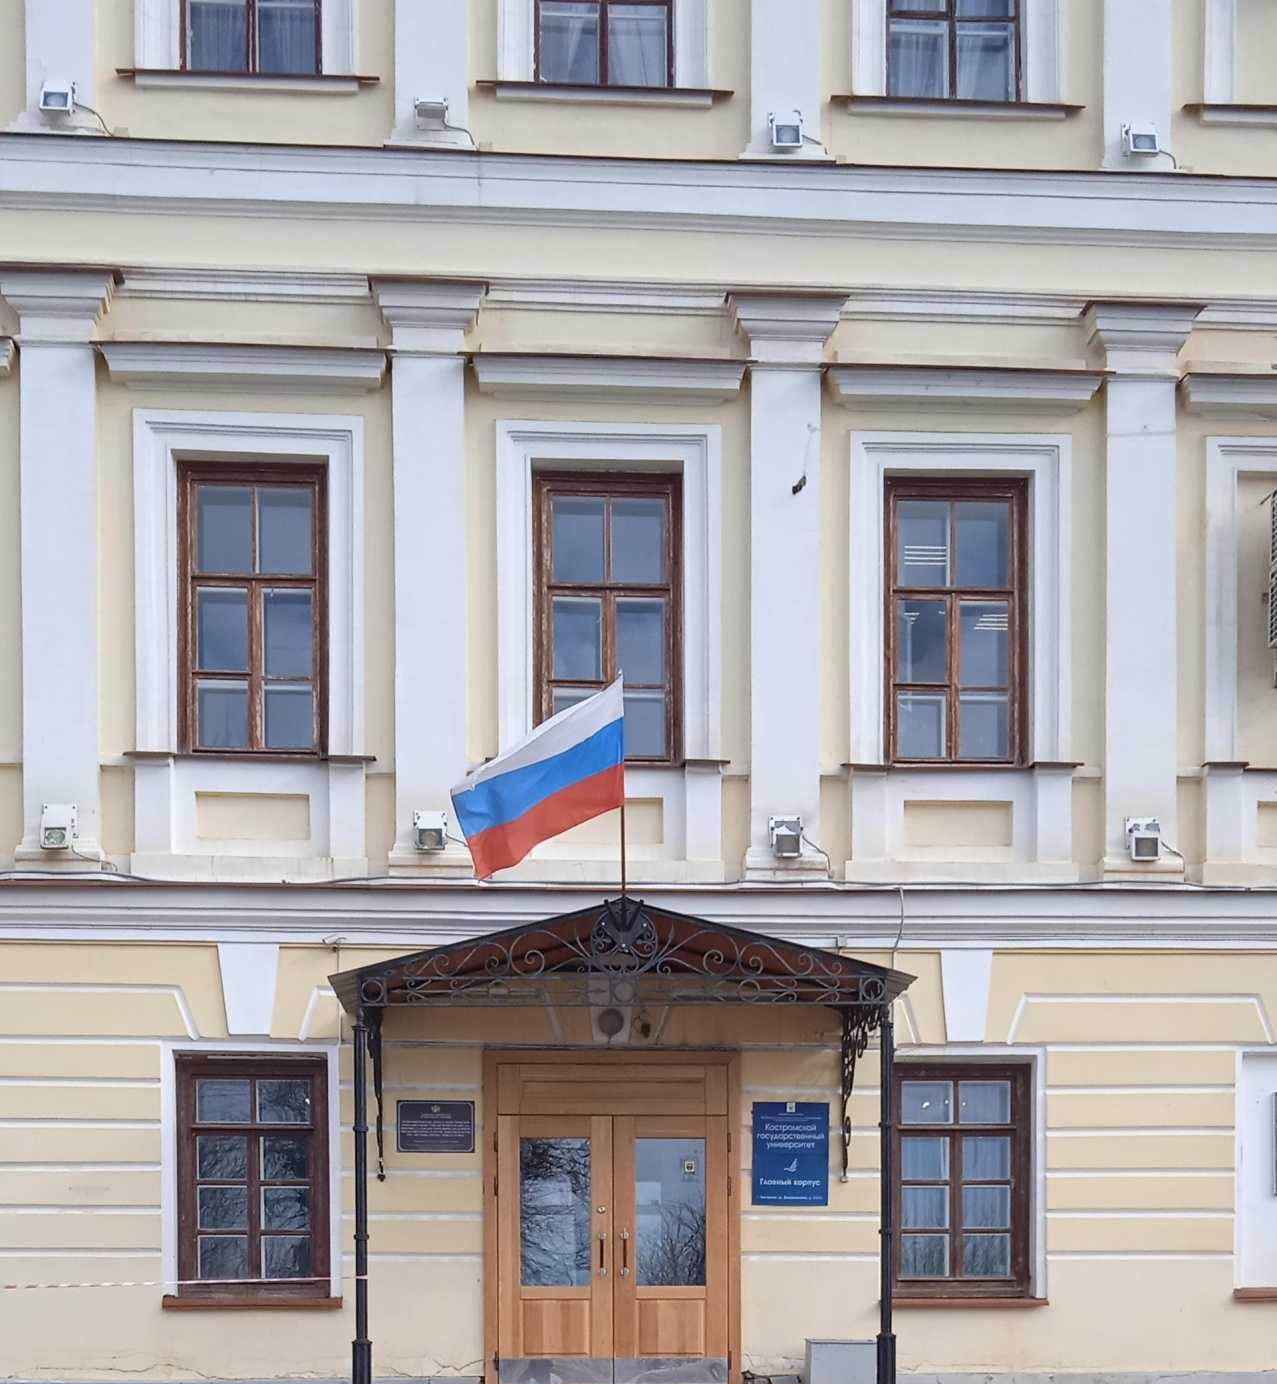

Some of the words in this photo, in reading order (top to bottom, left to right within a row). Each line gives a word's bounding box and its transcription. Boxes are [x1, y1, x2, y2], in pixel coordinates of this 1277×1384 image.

[764, 1123, 816, 1132] Костромской
[757, 1132, 824, 1141] государственный
[759, 1178, 791, 1186] Главный
[793, 1180, 821, 1188] корпус
